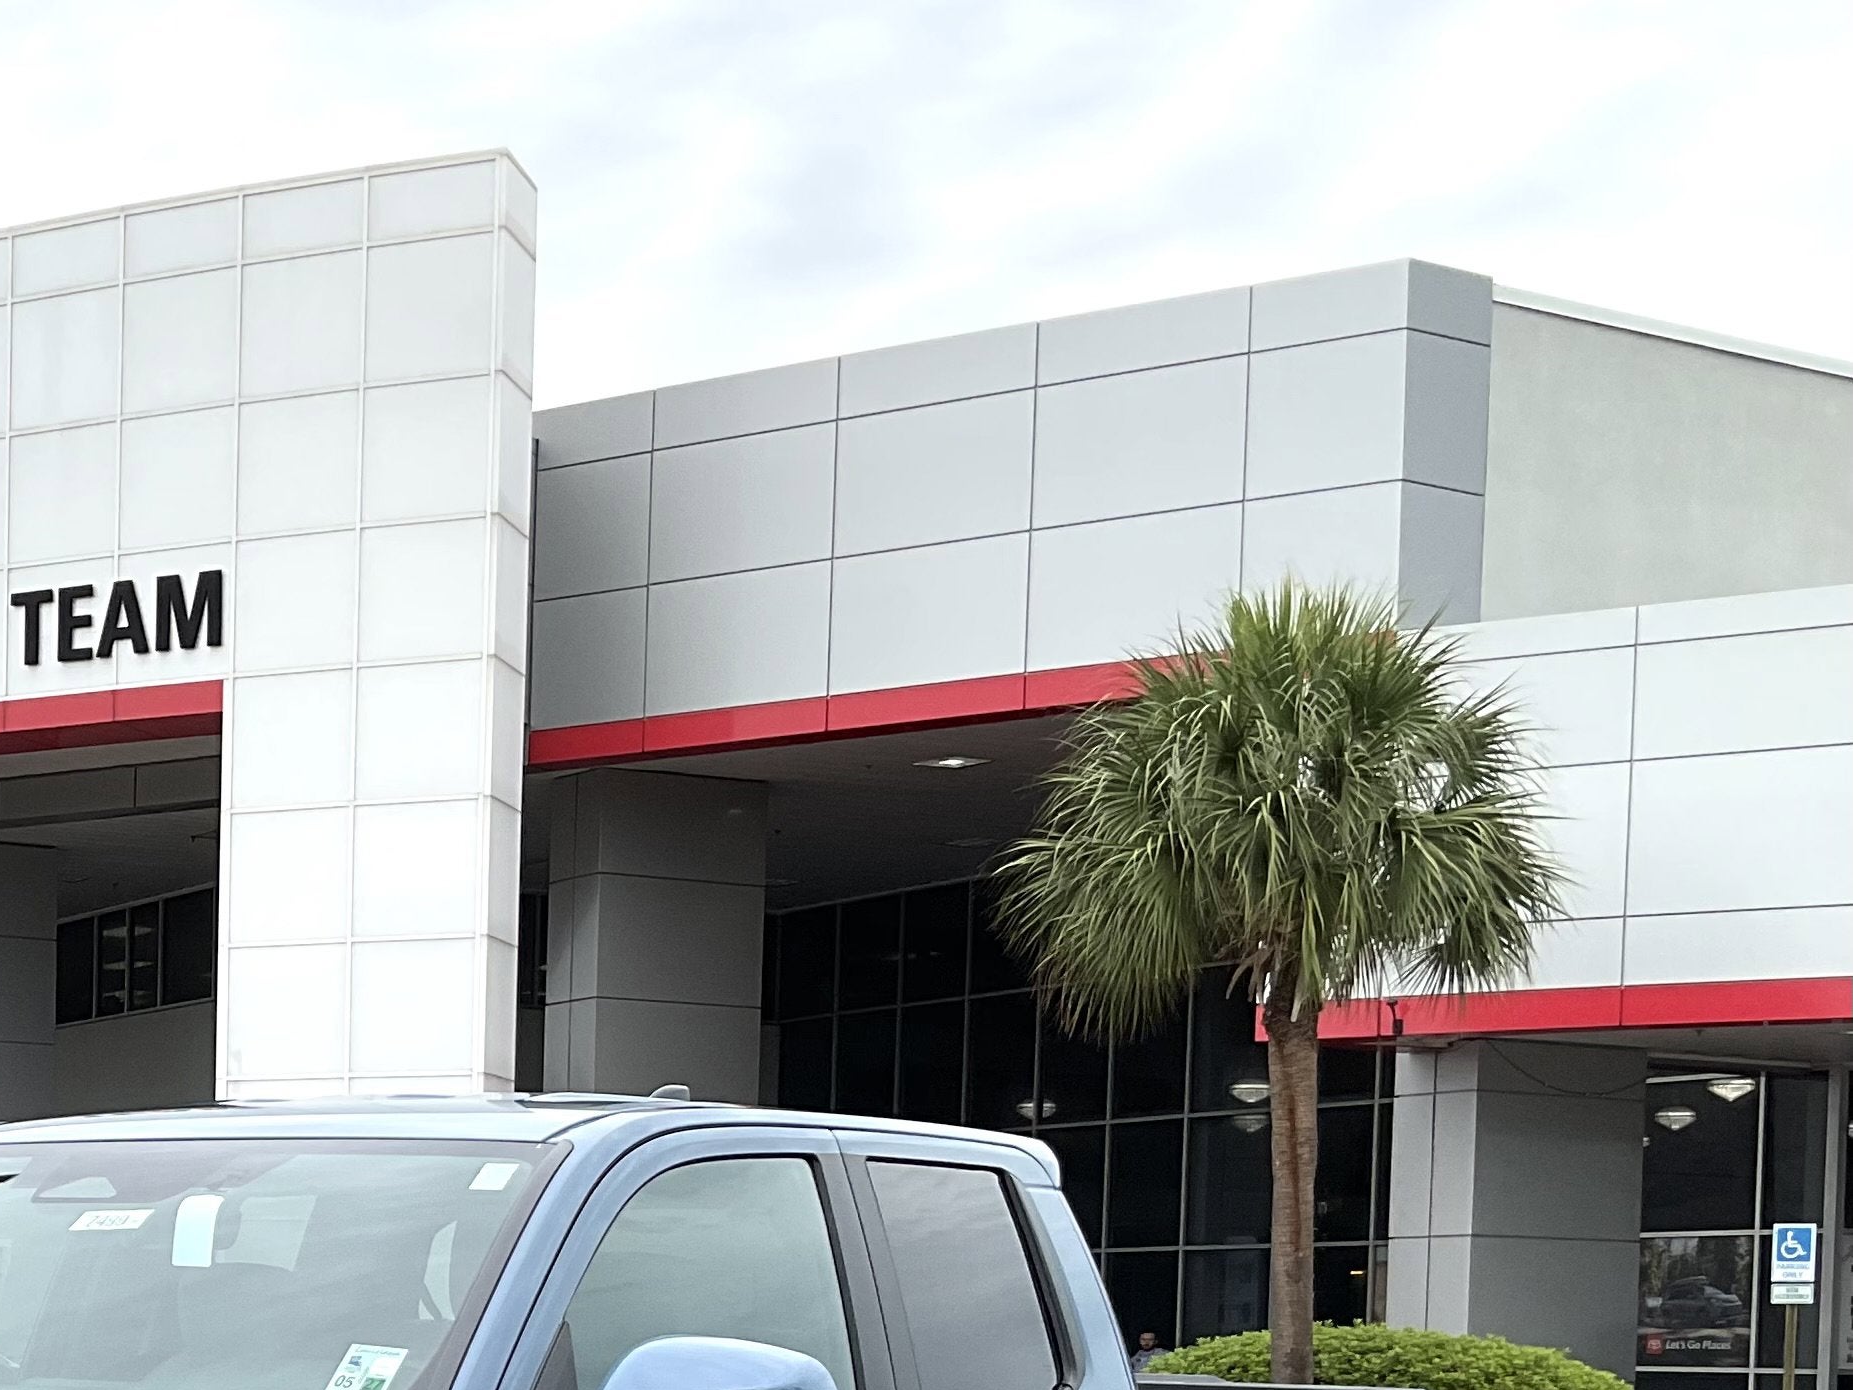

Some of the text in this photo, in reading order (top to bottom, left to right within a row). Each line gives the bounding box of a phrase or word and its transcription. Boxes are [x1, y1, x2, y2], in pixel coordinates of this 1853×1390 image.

[10, 569, 225, 667] TEAM
[1665, 1340, 1731, 1350] Let's Go Places
[333, 1374, 356, 1389] 05
